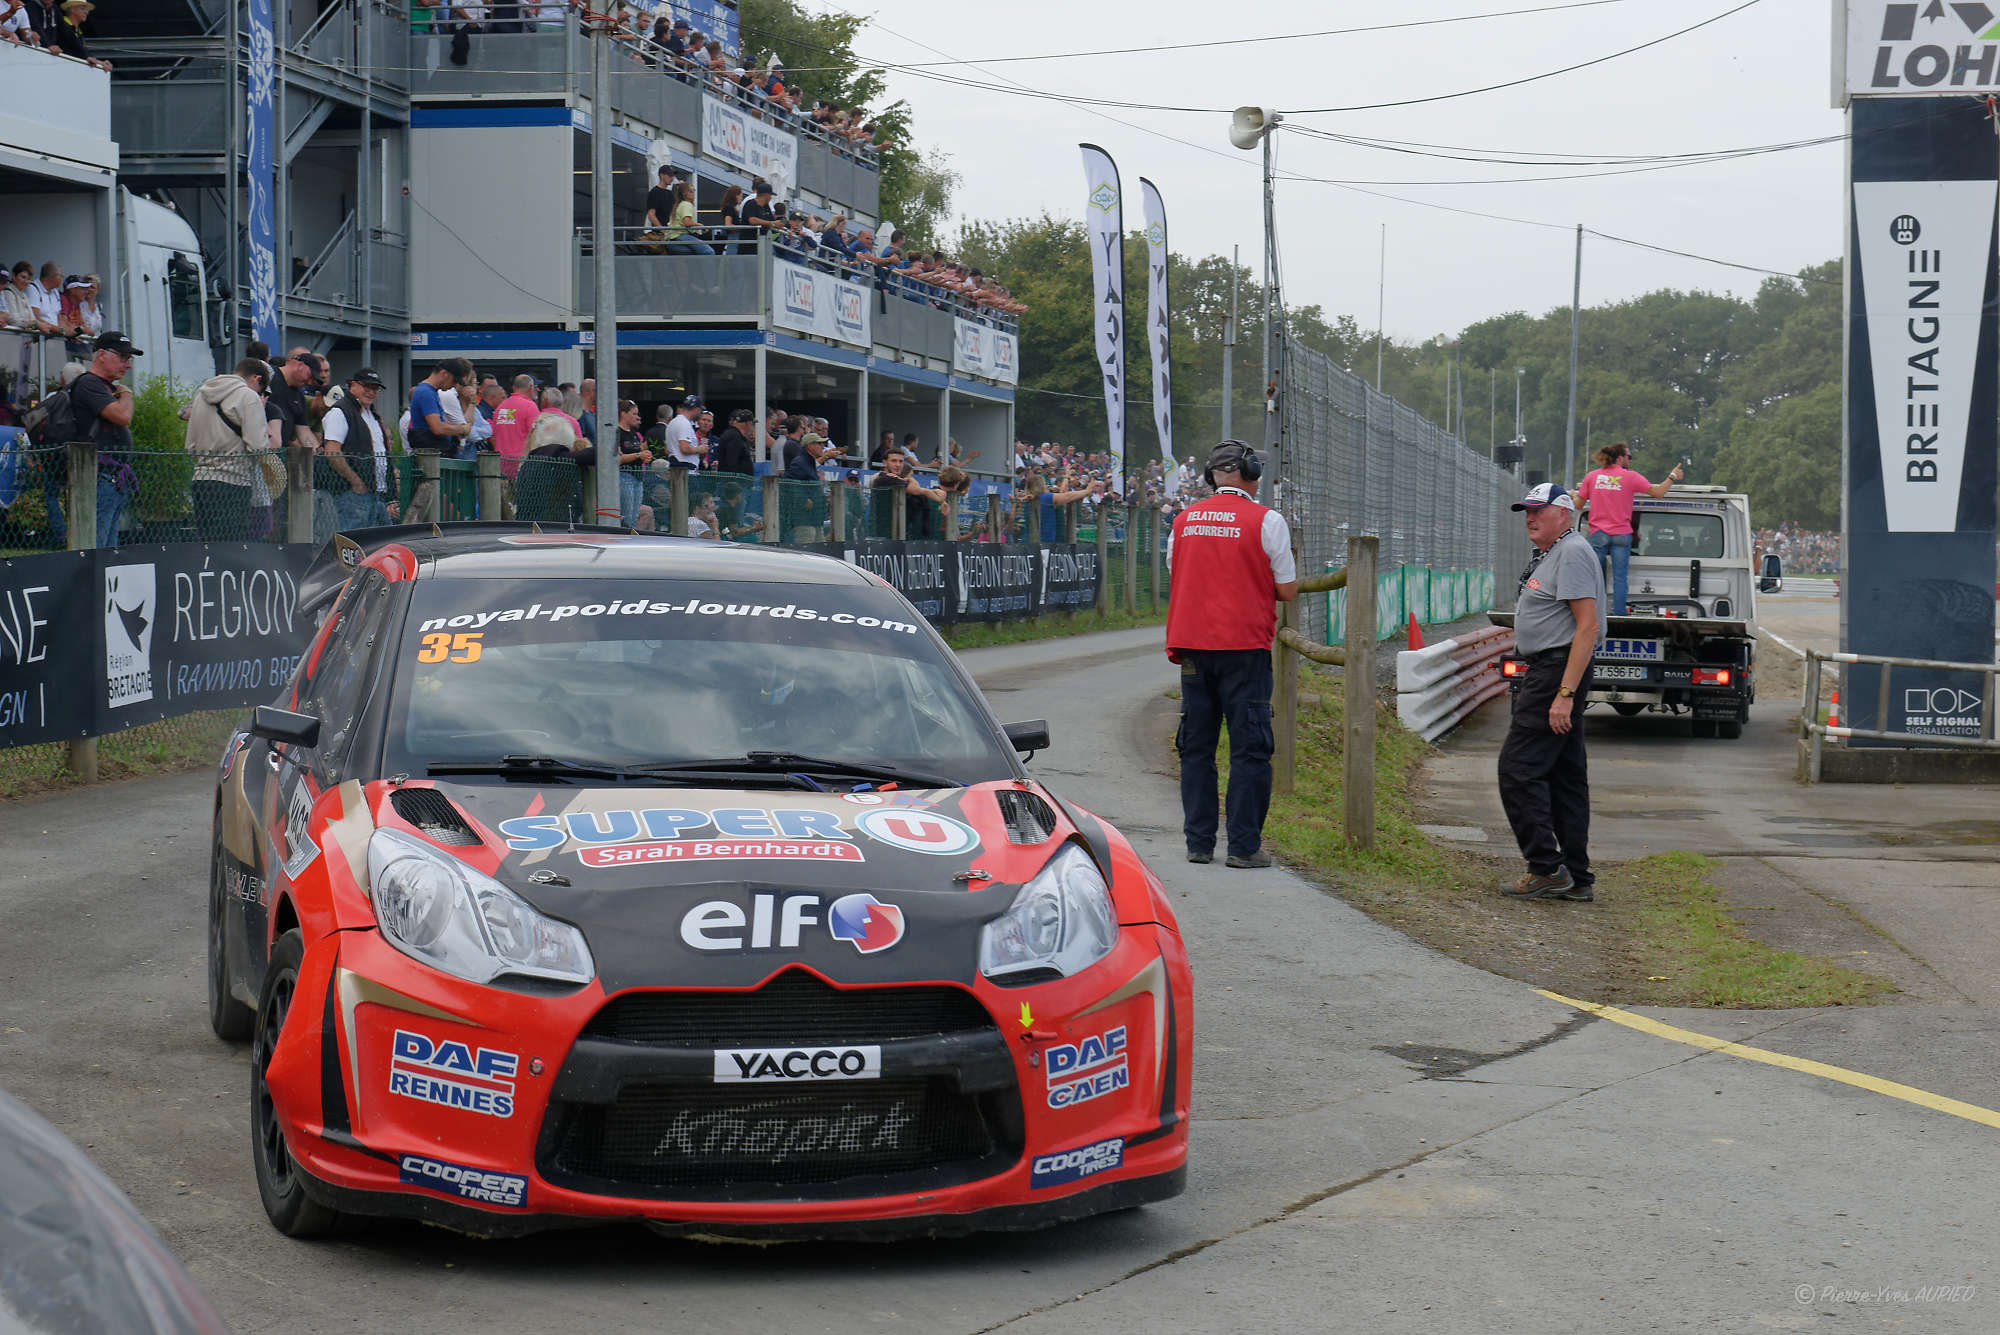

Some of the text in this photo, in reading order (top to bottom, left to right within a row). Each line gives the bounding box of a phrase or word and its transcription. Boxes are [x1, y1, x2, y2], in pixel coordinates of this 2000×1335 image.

[1871, 44, 2000, 88] LOH
[1906, 249, 1941, 483] BRETAGNE
[1181, 525, 1241, 538] ONCURRENTS
[173, 556, 297, 642] RÉGION
[418, 599, 918, 635] noyal-poids-lourds.com
[417, 632, 484, 664] 35
[108, 671, 152, 700] BRETAGNE
[177, 659, 262, 695] RANNVRO
[1664, 671, 1691, 679] DAILY
[1905, 716, 1981, 726] SELF SIGNAL
[1905, 726, 1981, 735] SIGNALISATION
[498, 808, 949, 851] SUPER U
[597, 842, 845, 863] Sarah Bernhardt
[681, 894, 820, 950] elf
[392, 1029, 519, 1079] DAF
[731, 1049, 866, 1078] YACCO
[1045, 1025, 1127, 1075] DAF
[390, 1071, 514, 1118] RENNES
[1048, 1066, 1129, 1109] CAEN
[1033, 1138, 1124, 1175] COOPER
[1079, 1153, 1121, 1176] TIRES
[402, 1156, 525, 1195] COOPER
[458, 1183, 522, 1206] TIRES
